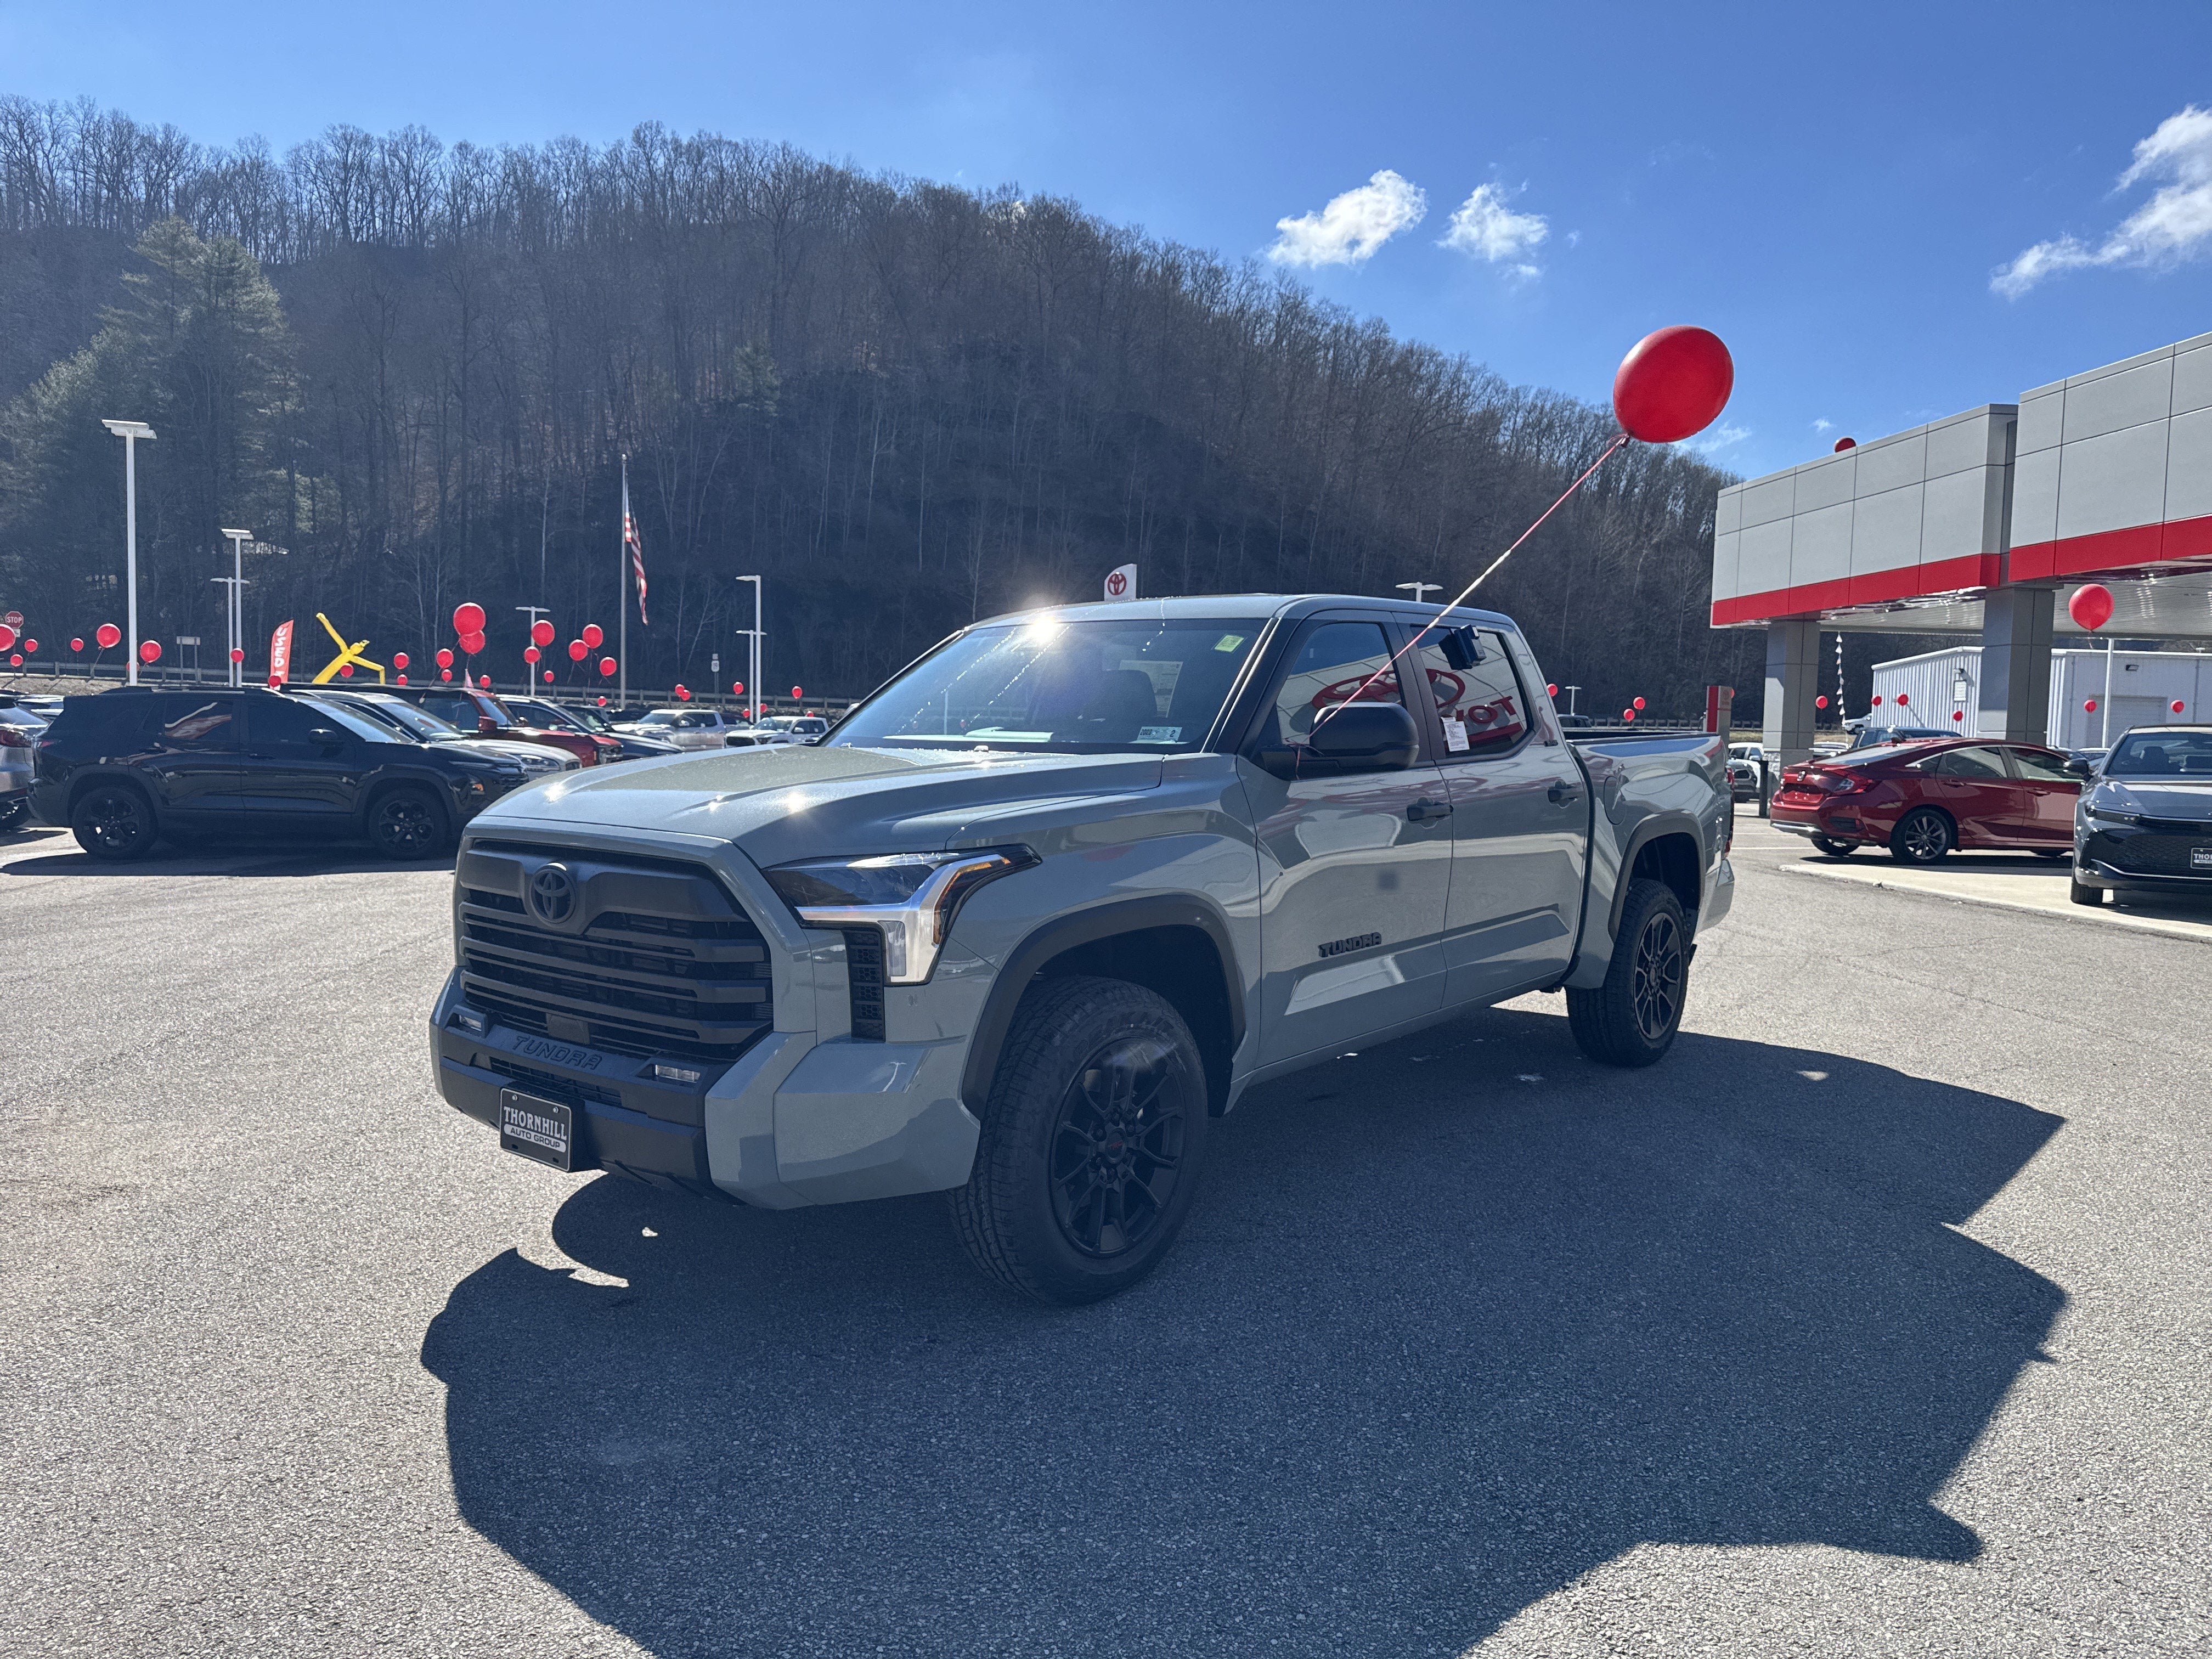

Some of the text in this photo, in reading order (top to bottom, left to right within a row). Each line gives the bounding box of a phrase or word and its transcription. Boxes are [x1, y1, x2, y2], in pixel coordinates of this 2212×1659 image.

[274, 626, 287, 668] USED
[1318, 932, 1382, 957] TUNDRA
[512, 1035, 603, 1070] TUNDRA
[504, 1106, 567, 1141] THORNHILL
[510, 1127, 560, 1148] AUTO GROUP
